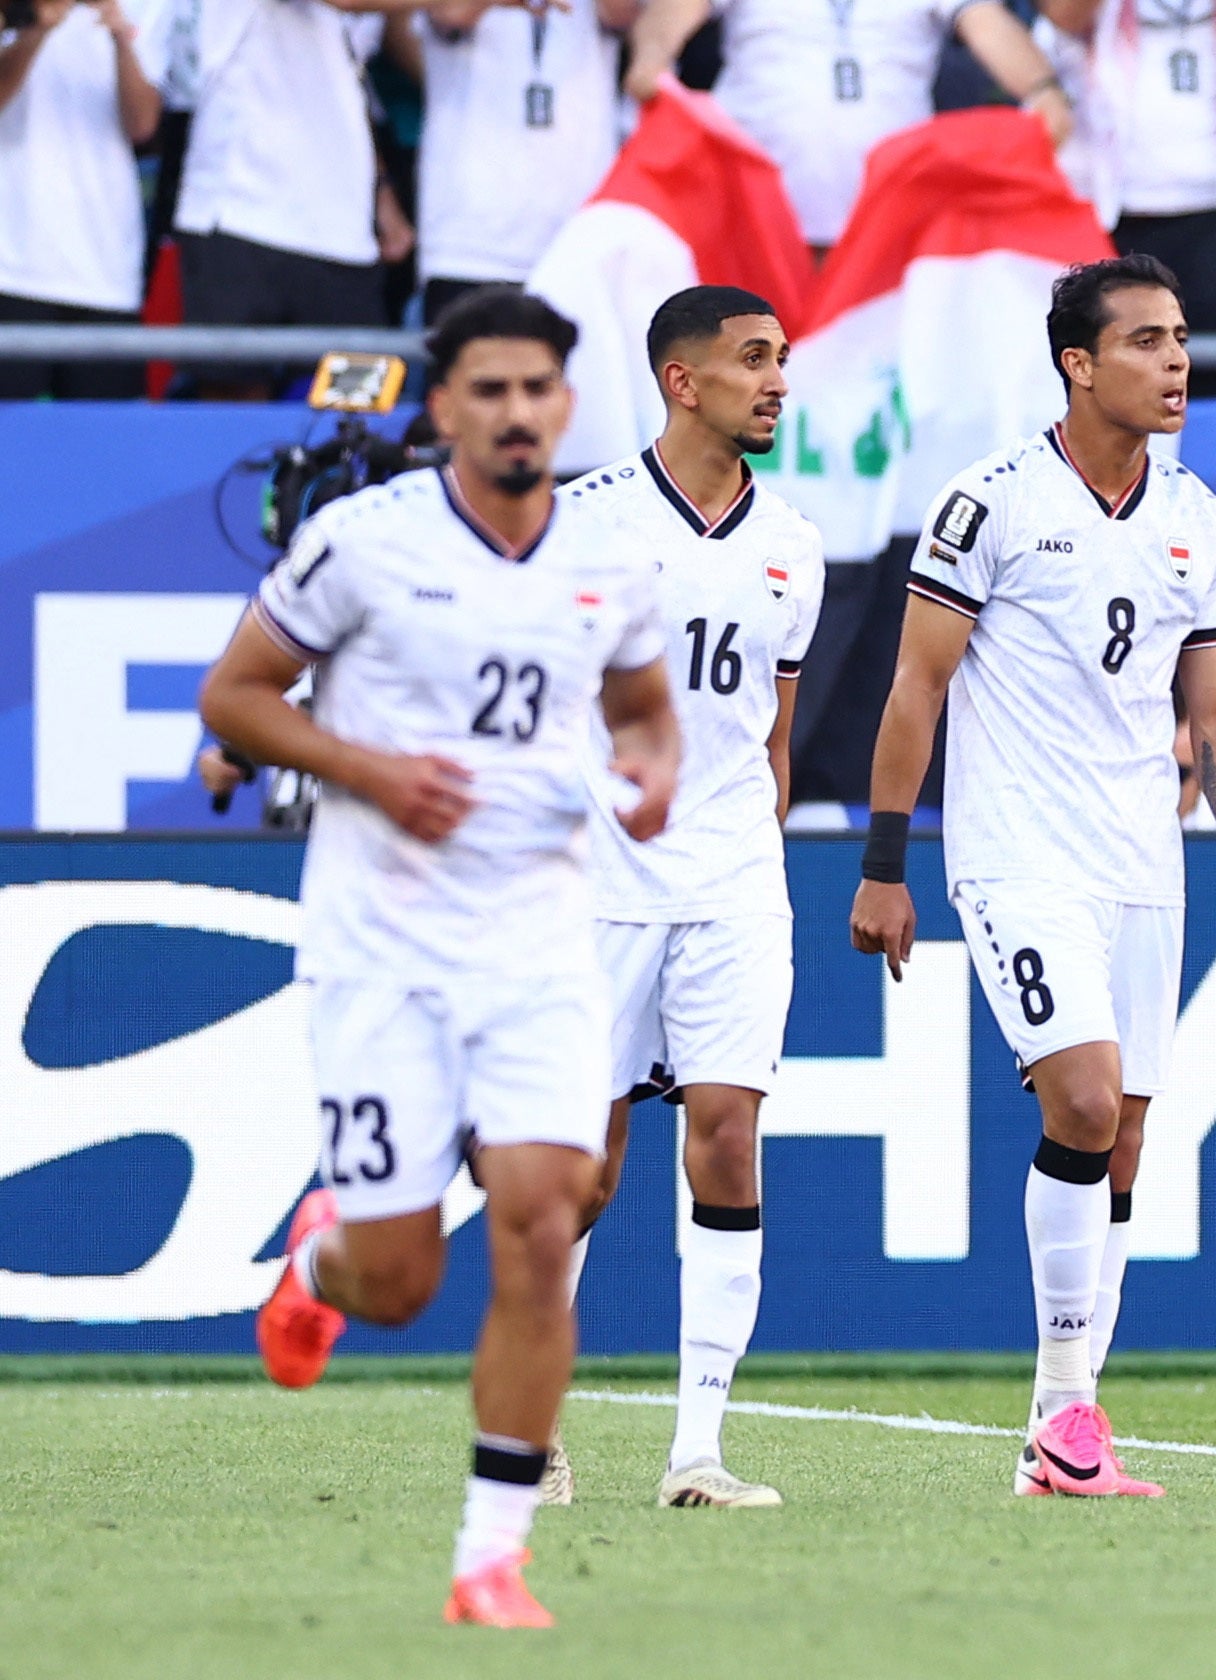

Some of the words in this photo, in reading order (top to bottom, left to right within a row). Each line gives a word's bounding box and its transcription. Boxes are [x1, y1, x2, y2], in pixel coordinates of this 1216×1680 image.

[1035, 539, 1073, 554] JAKO
[686, 617, 743, 696] 16
[1102, 597, 1136, 675] 8
[472, 657, 546, 742] 23
[1013, 947, 1055, 1026] 8
[1049, 1312, 1094, 1330] JAK
